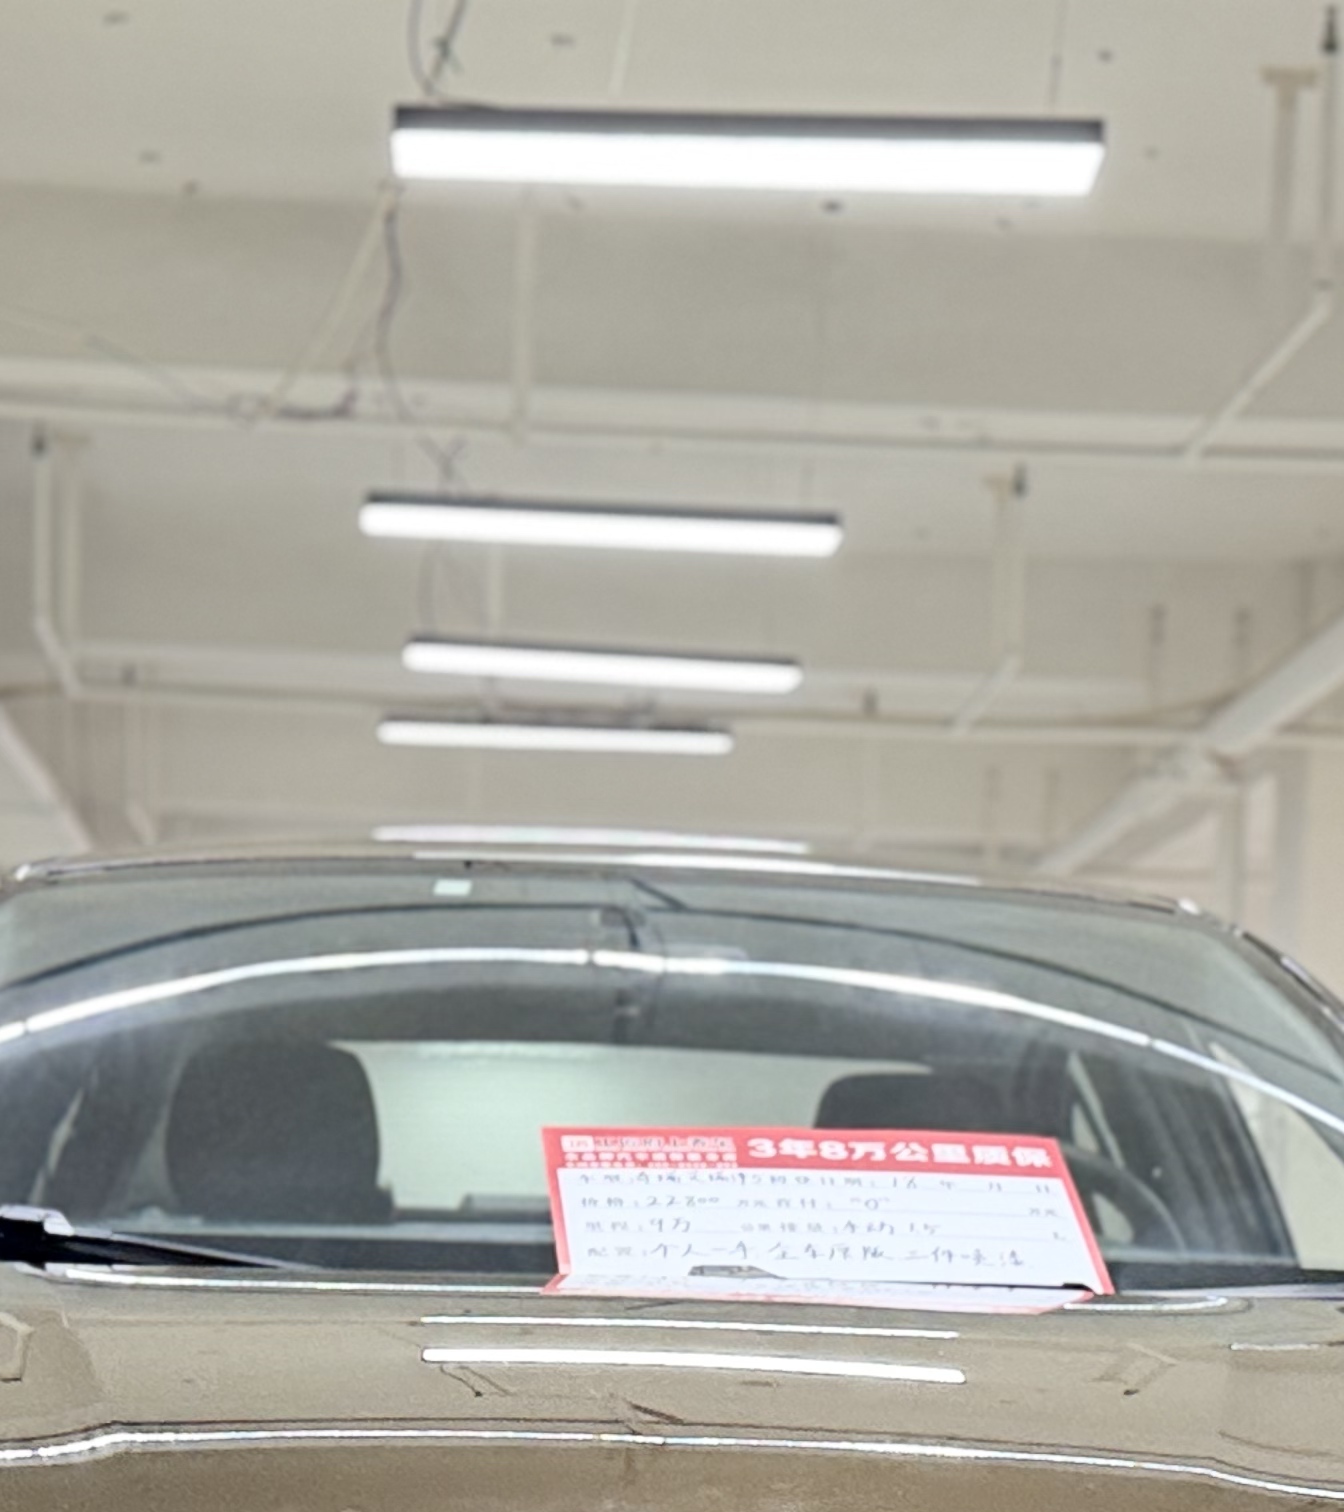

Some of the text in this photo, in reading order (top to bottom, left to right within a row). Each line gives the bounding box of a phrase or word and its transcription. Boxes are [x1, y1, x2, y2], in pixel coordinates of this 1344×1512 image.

[747, 1138, 1053, 1167] 3年8万公里质保
